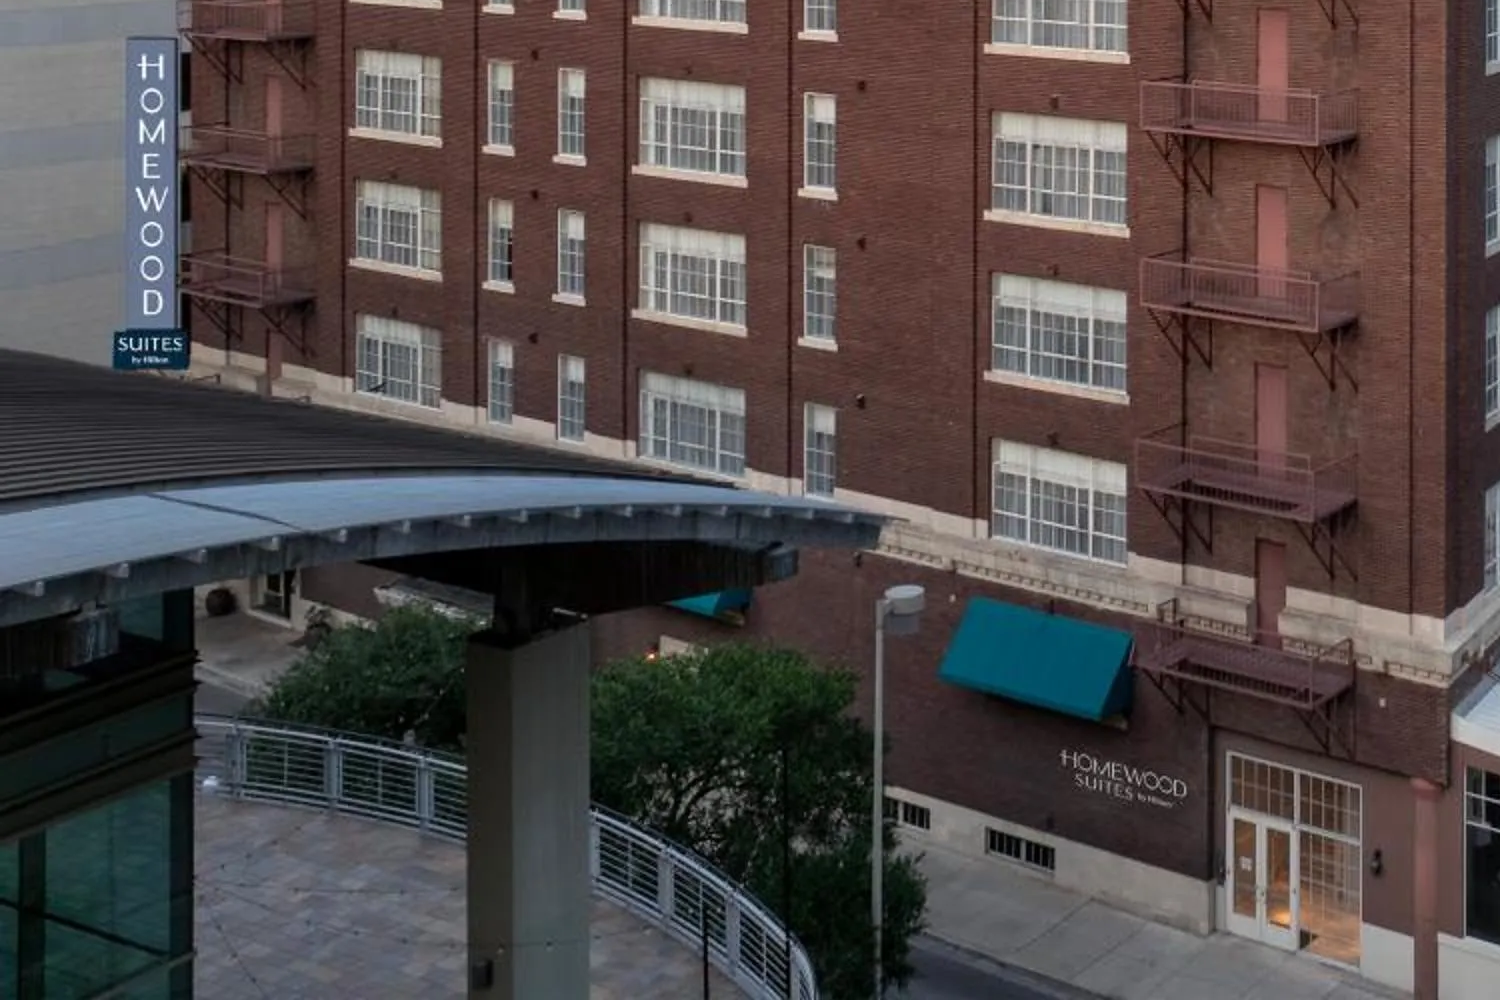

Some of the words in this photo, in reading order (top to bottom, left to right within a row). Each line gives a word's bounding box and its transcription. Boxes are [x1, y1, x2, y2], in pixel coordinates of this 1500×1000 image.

[136, 54, 169, 315] HOMEWOOD
[118, 337, 184, 352] SUITES
[1060, 749, 1187, 798] HOMEWOOD
[1074, 773, 1133, 801] SUITES
